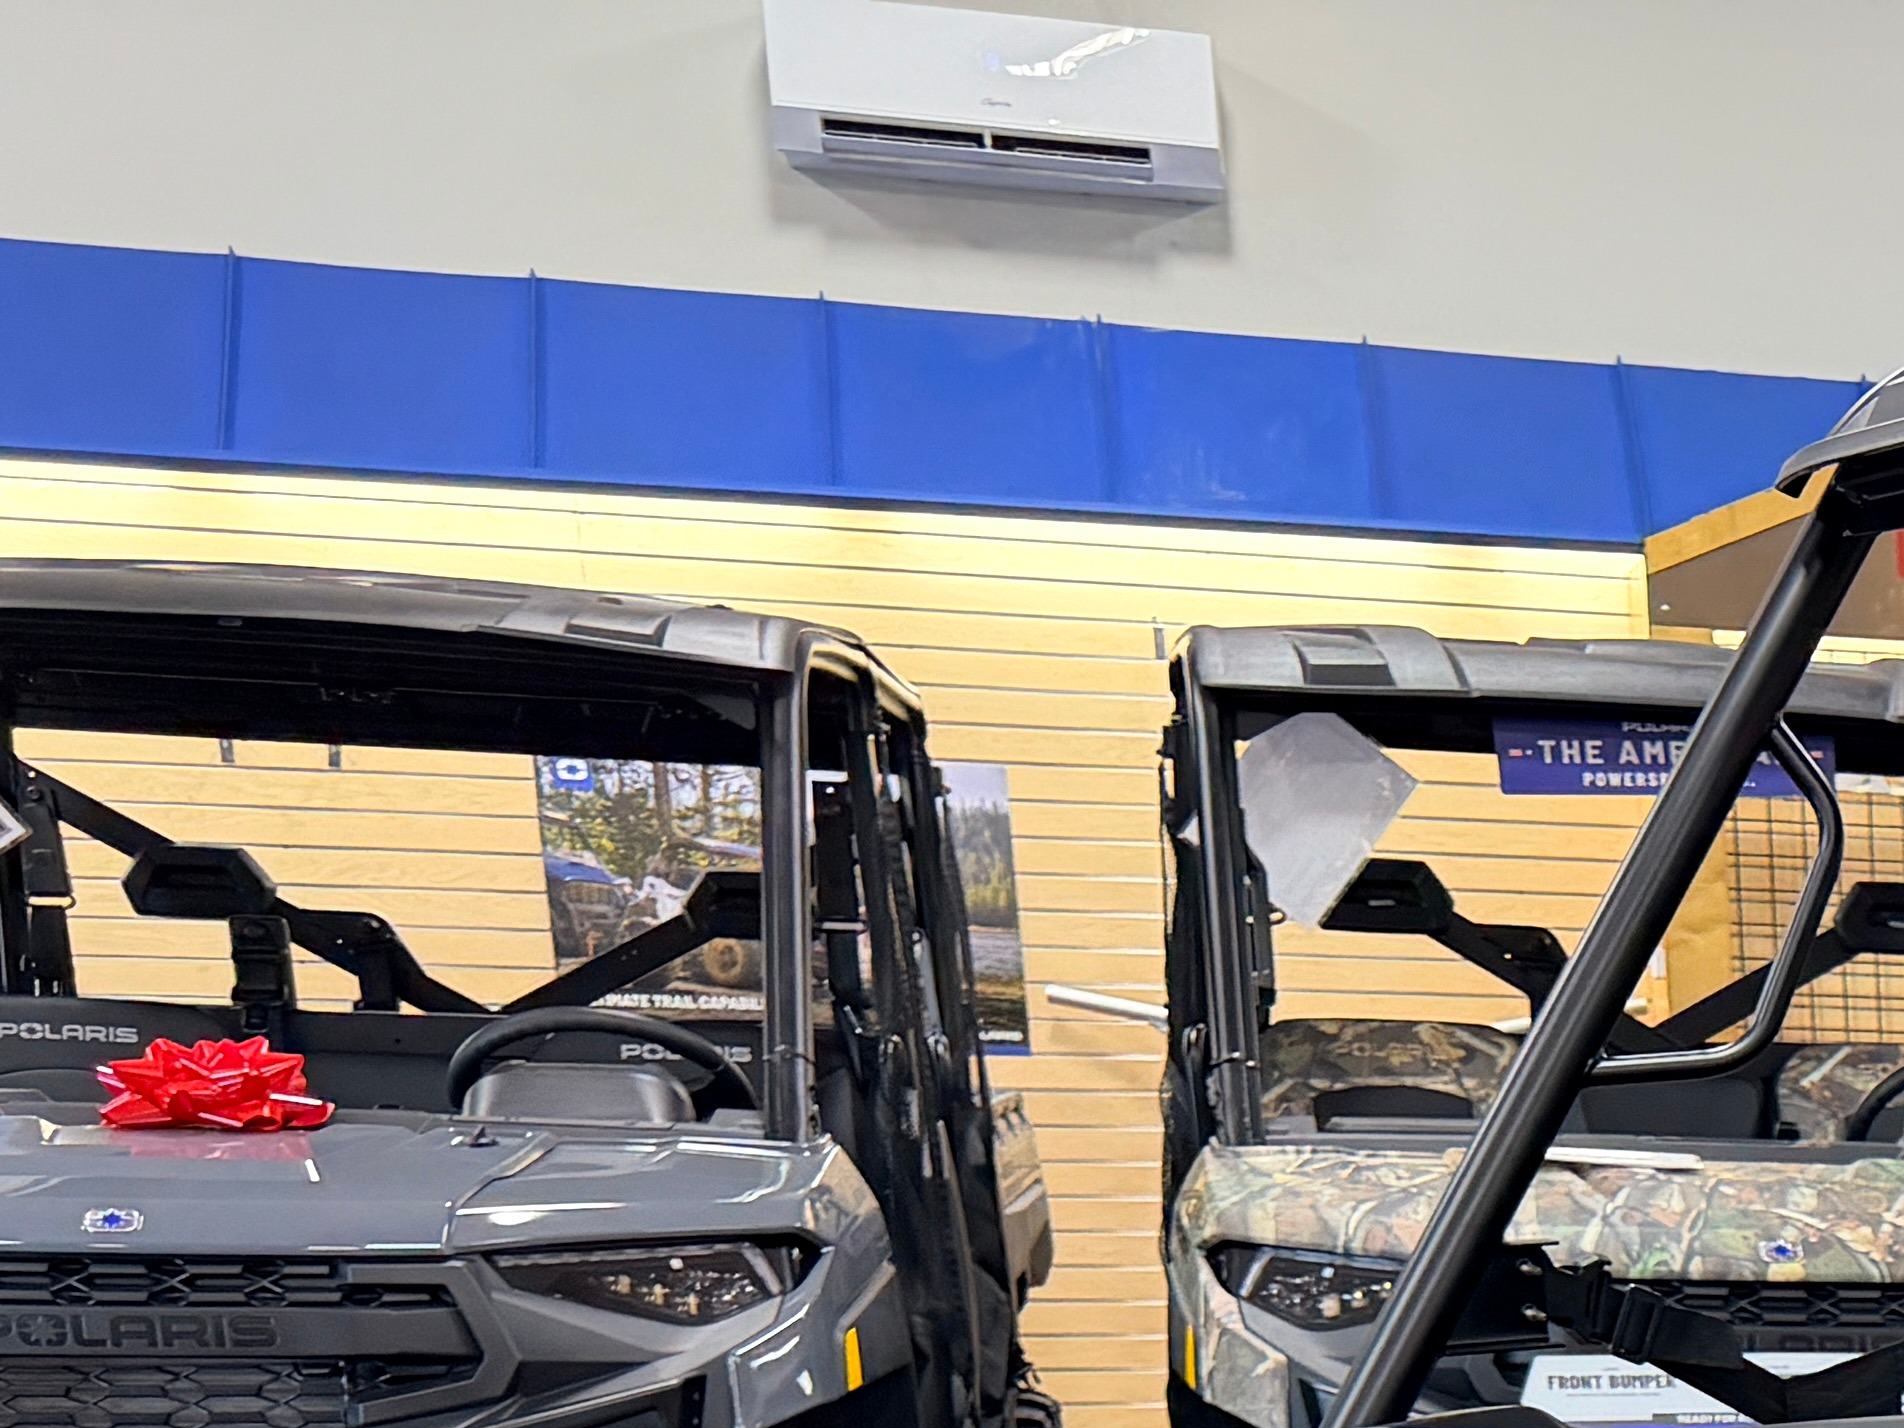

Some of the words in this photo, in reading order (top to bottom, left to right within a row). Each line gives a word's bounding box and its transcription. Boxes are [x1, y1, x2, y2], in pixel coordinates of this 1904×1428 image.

[1537, 740, 1605, 764] THE
[0, 1021, 139, 1043] POLARIS
[620, 1043, 753, 1063] POLIS
[1547, 1374, 1604, 1390] FRONT
[1608, 1374, 1677, 1390] BUMPER
